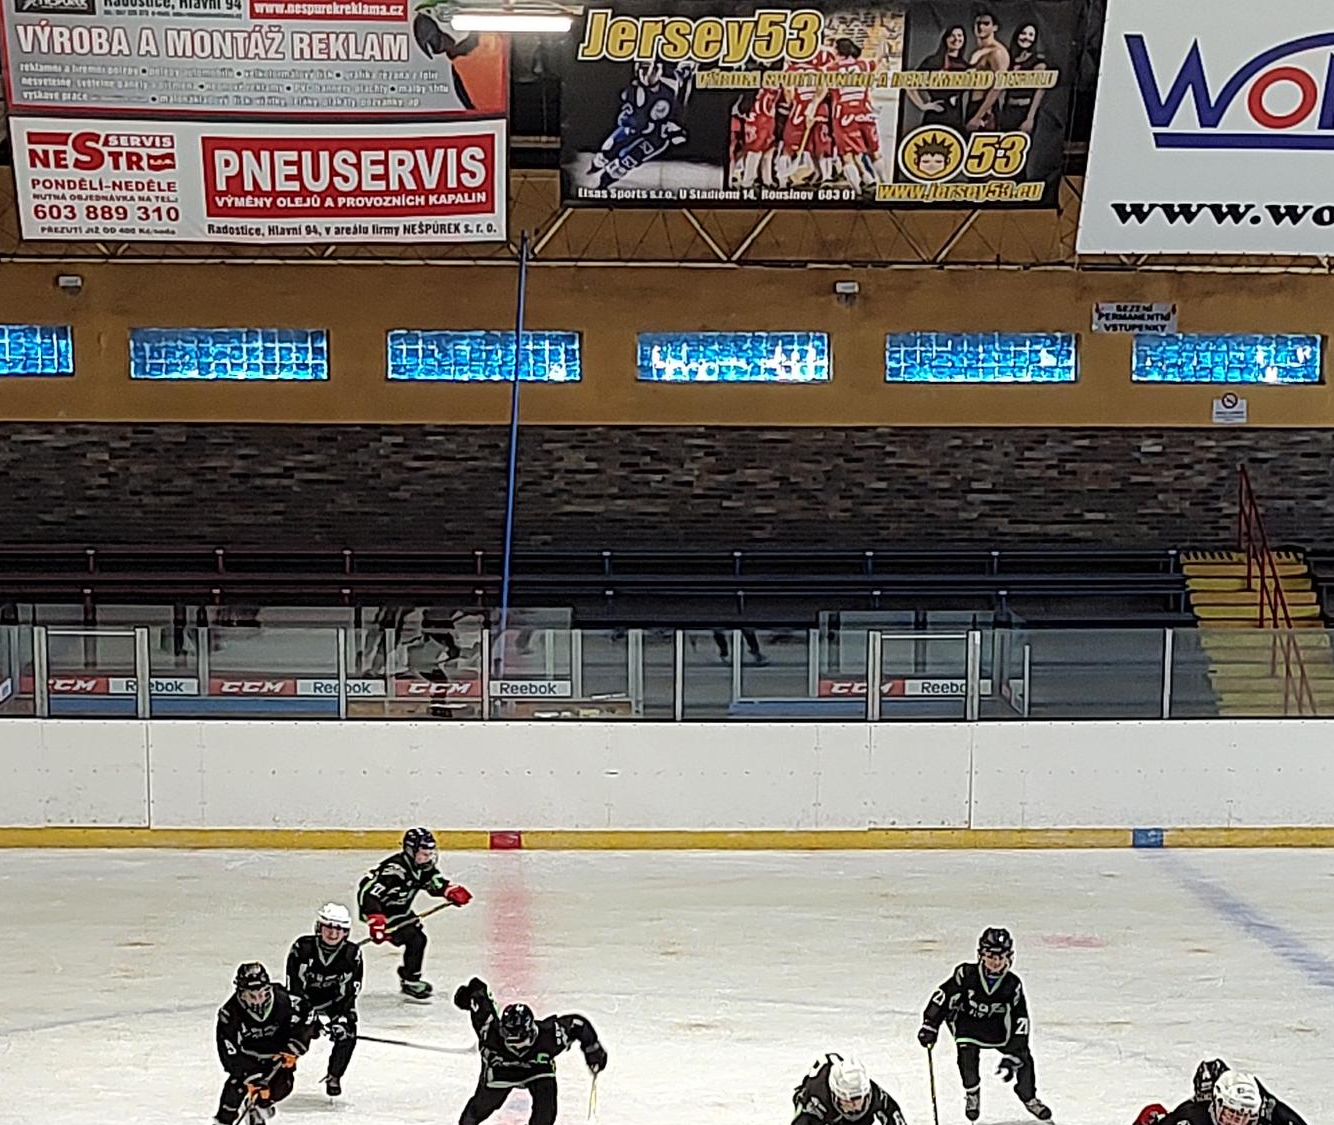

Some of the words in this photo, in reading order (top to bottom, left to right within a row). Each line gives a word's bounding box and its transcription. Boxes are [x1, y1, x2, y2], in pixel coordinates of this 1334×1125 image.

[16, 19, 131, 56] VÝROBA
[137, 26, 159, 57] A
[167, 24, 284, 61] MONTÁŽ
[291, 32, 408, 61] REKLAM
[581, 10, 822, 63] Jersey53
[108, 135, 172, 148] SERVIS
[967, 134, 1027, 174] 53
[214, 147, 486, 192] PNEUSERVIS
[31, 178, 177, 192] PONDĚLÍ-NEDĚLE
[69, 193, 135, 202] OBJEDNÁVKA
[138, 195, 151, 203] NA
[215, 194, 272, 208] VÝMĚNY
[276, 194, 321, 207] OLEJŮ
[324, 197, 334, 207] A
[337, 193, 425, 207] PROVOZNÍCH
[428, 191, 486, 205] KAPALIN
[610, 188, 647, 201] Sports
[679, 189, 687, 200] U
[818, 190, 841, 200] 683
[842, 190, 855, 200] 01
[34, 204, 77, 220] 603
[85, 205, 128, 221] 889
[137, 206, 180, 222] 310
[207, 223, 265, 237] Radostice,
[268, 224, 302, 236] Hlavní
[1104, 323, 1166, 332] VSTUPENKY
[48, 679, 96, 692] CM
[220, 681, 285, 693] CCM
[499, 681, 557, 694] Reebok
